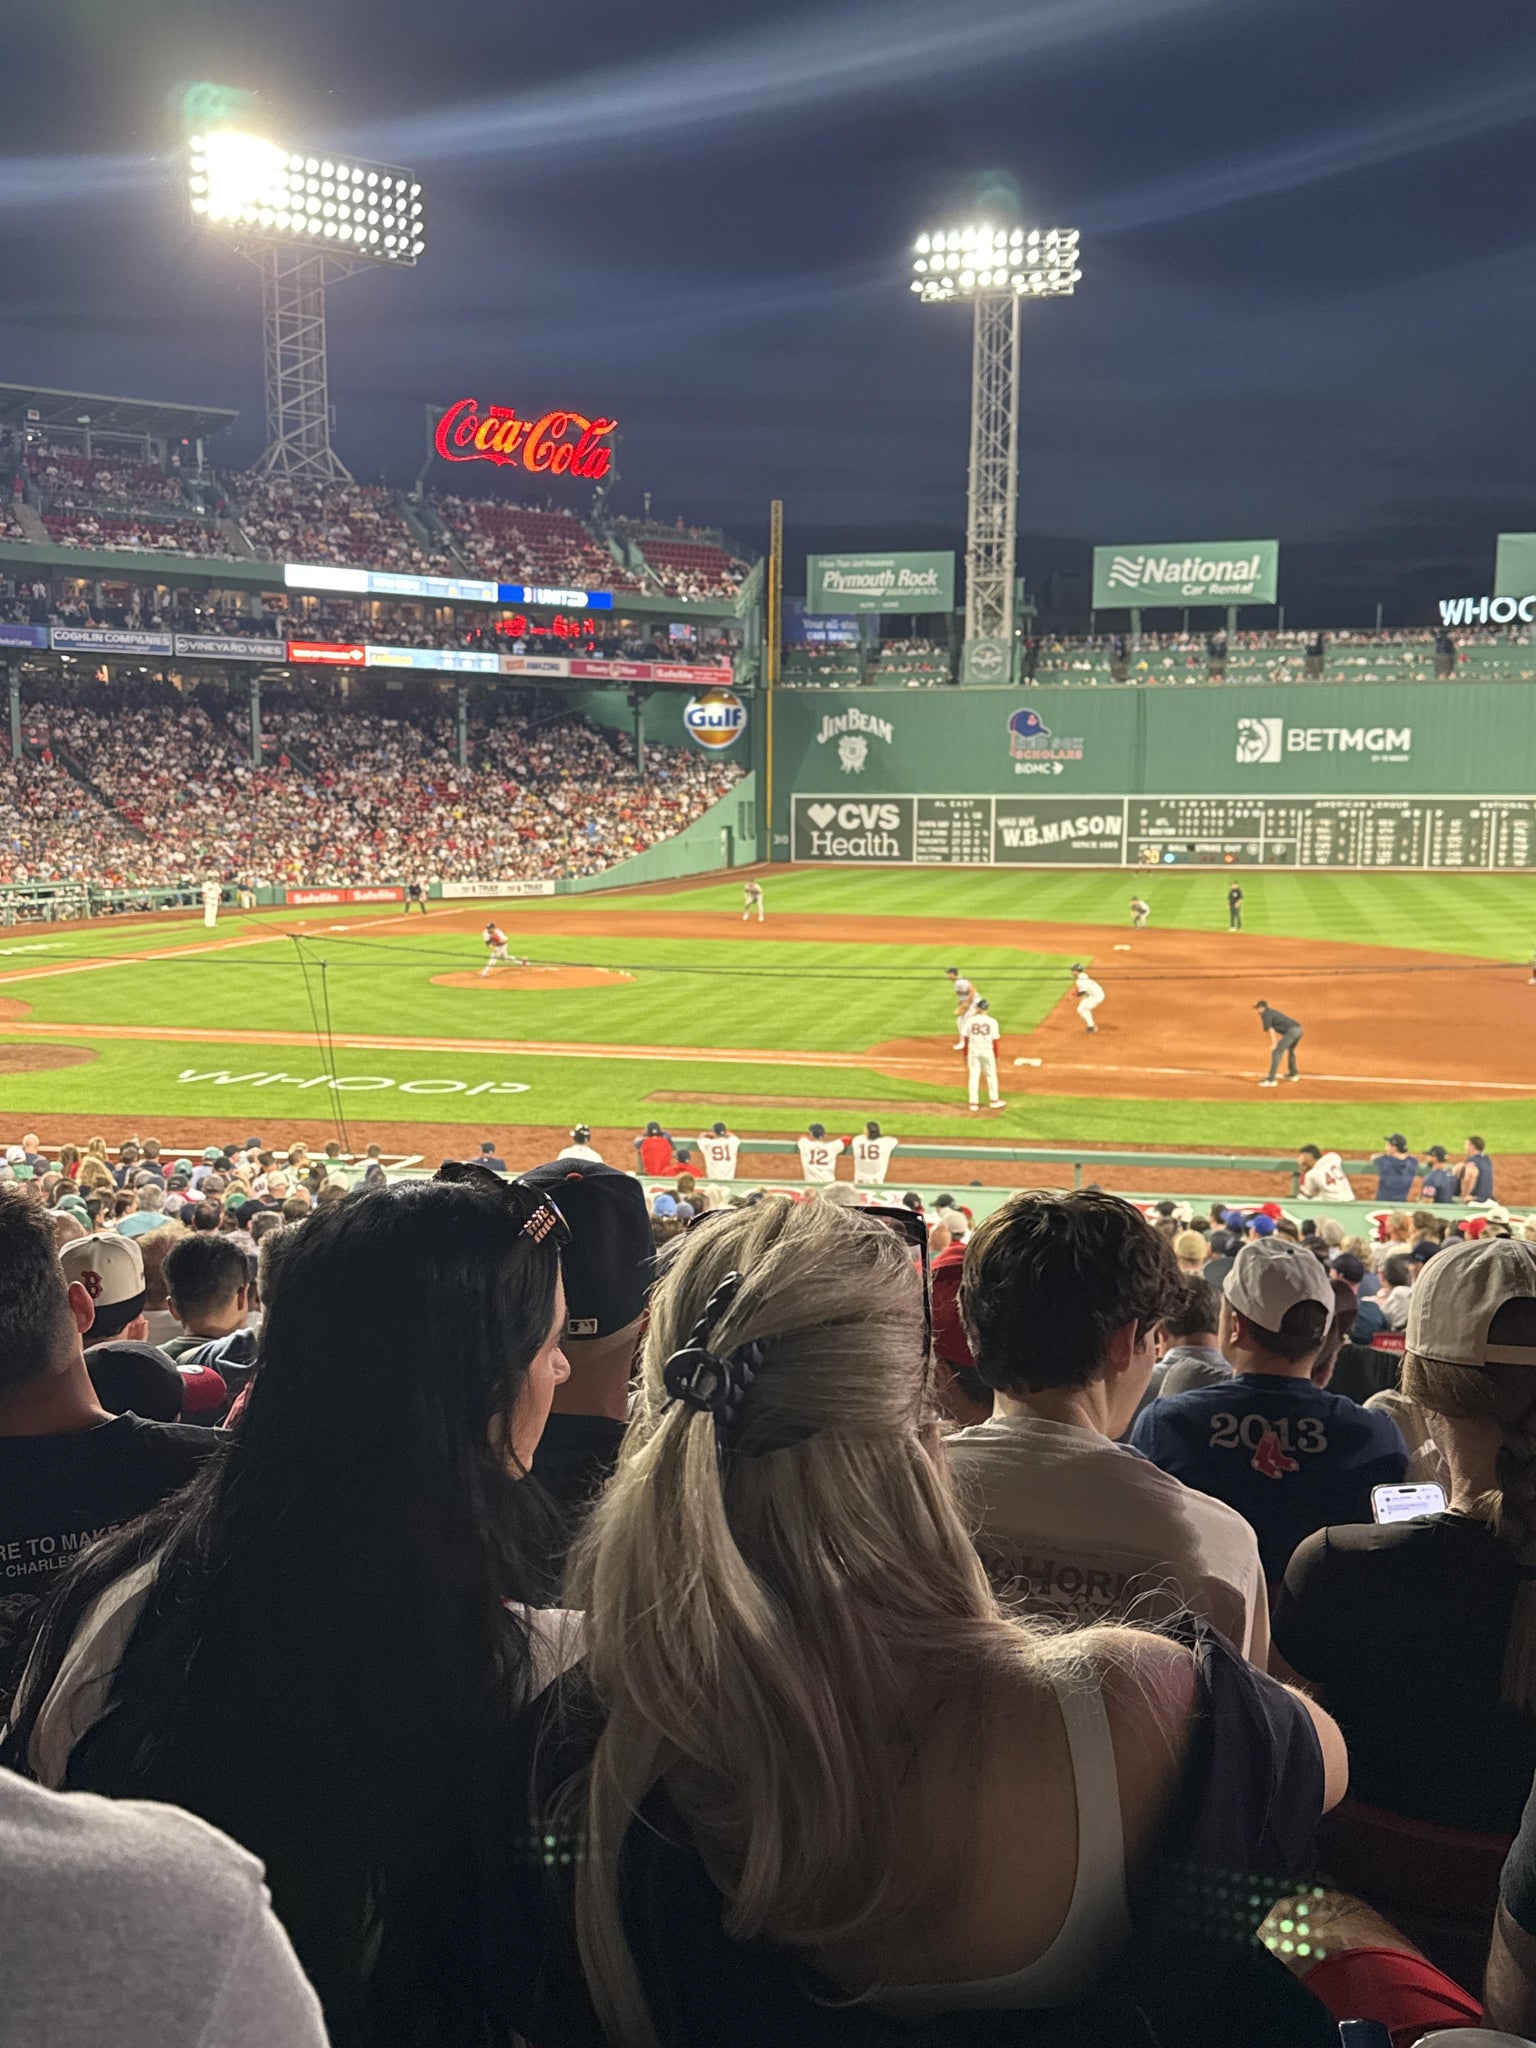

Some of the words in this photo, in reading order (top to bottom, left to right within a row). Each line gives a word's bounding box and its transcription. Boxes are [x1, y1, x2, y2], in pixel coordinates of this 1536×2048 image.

[435, 398, 618, 479] Coca-Cola
[823, 570, 895, 590] Plymouth
[898, 568, 939, 587] Rock
[1142, 555, 1260, 584] National
[1181, 584, 1206, 596] Car
[1209, 583, 1254, 595] Rental
[54, 631, 103, 643] COGHLIN
[104, 633, 170, 646] COMPANIES
[190, 642, 247, 654] VINEYARD
[688, 708, 742, 727] Gulf
[816, 715, 848, 745] JIM
[847, 707, 895, 745] BEAM
[1287, 728, 1412, 752] BETMGM
[838, 803, 901, 830] CVS
[810, 831, 901, 857] Health
[971, 1023, 990, 1036] 83
[176, 1069, 532, 1096] WHOOP
[808, 1149, 829, 1166] 12
[1208, 1412, 1328, 1453] 2013
[26, 1536, 55, 1556] TO
